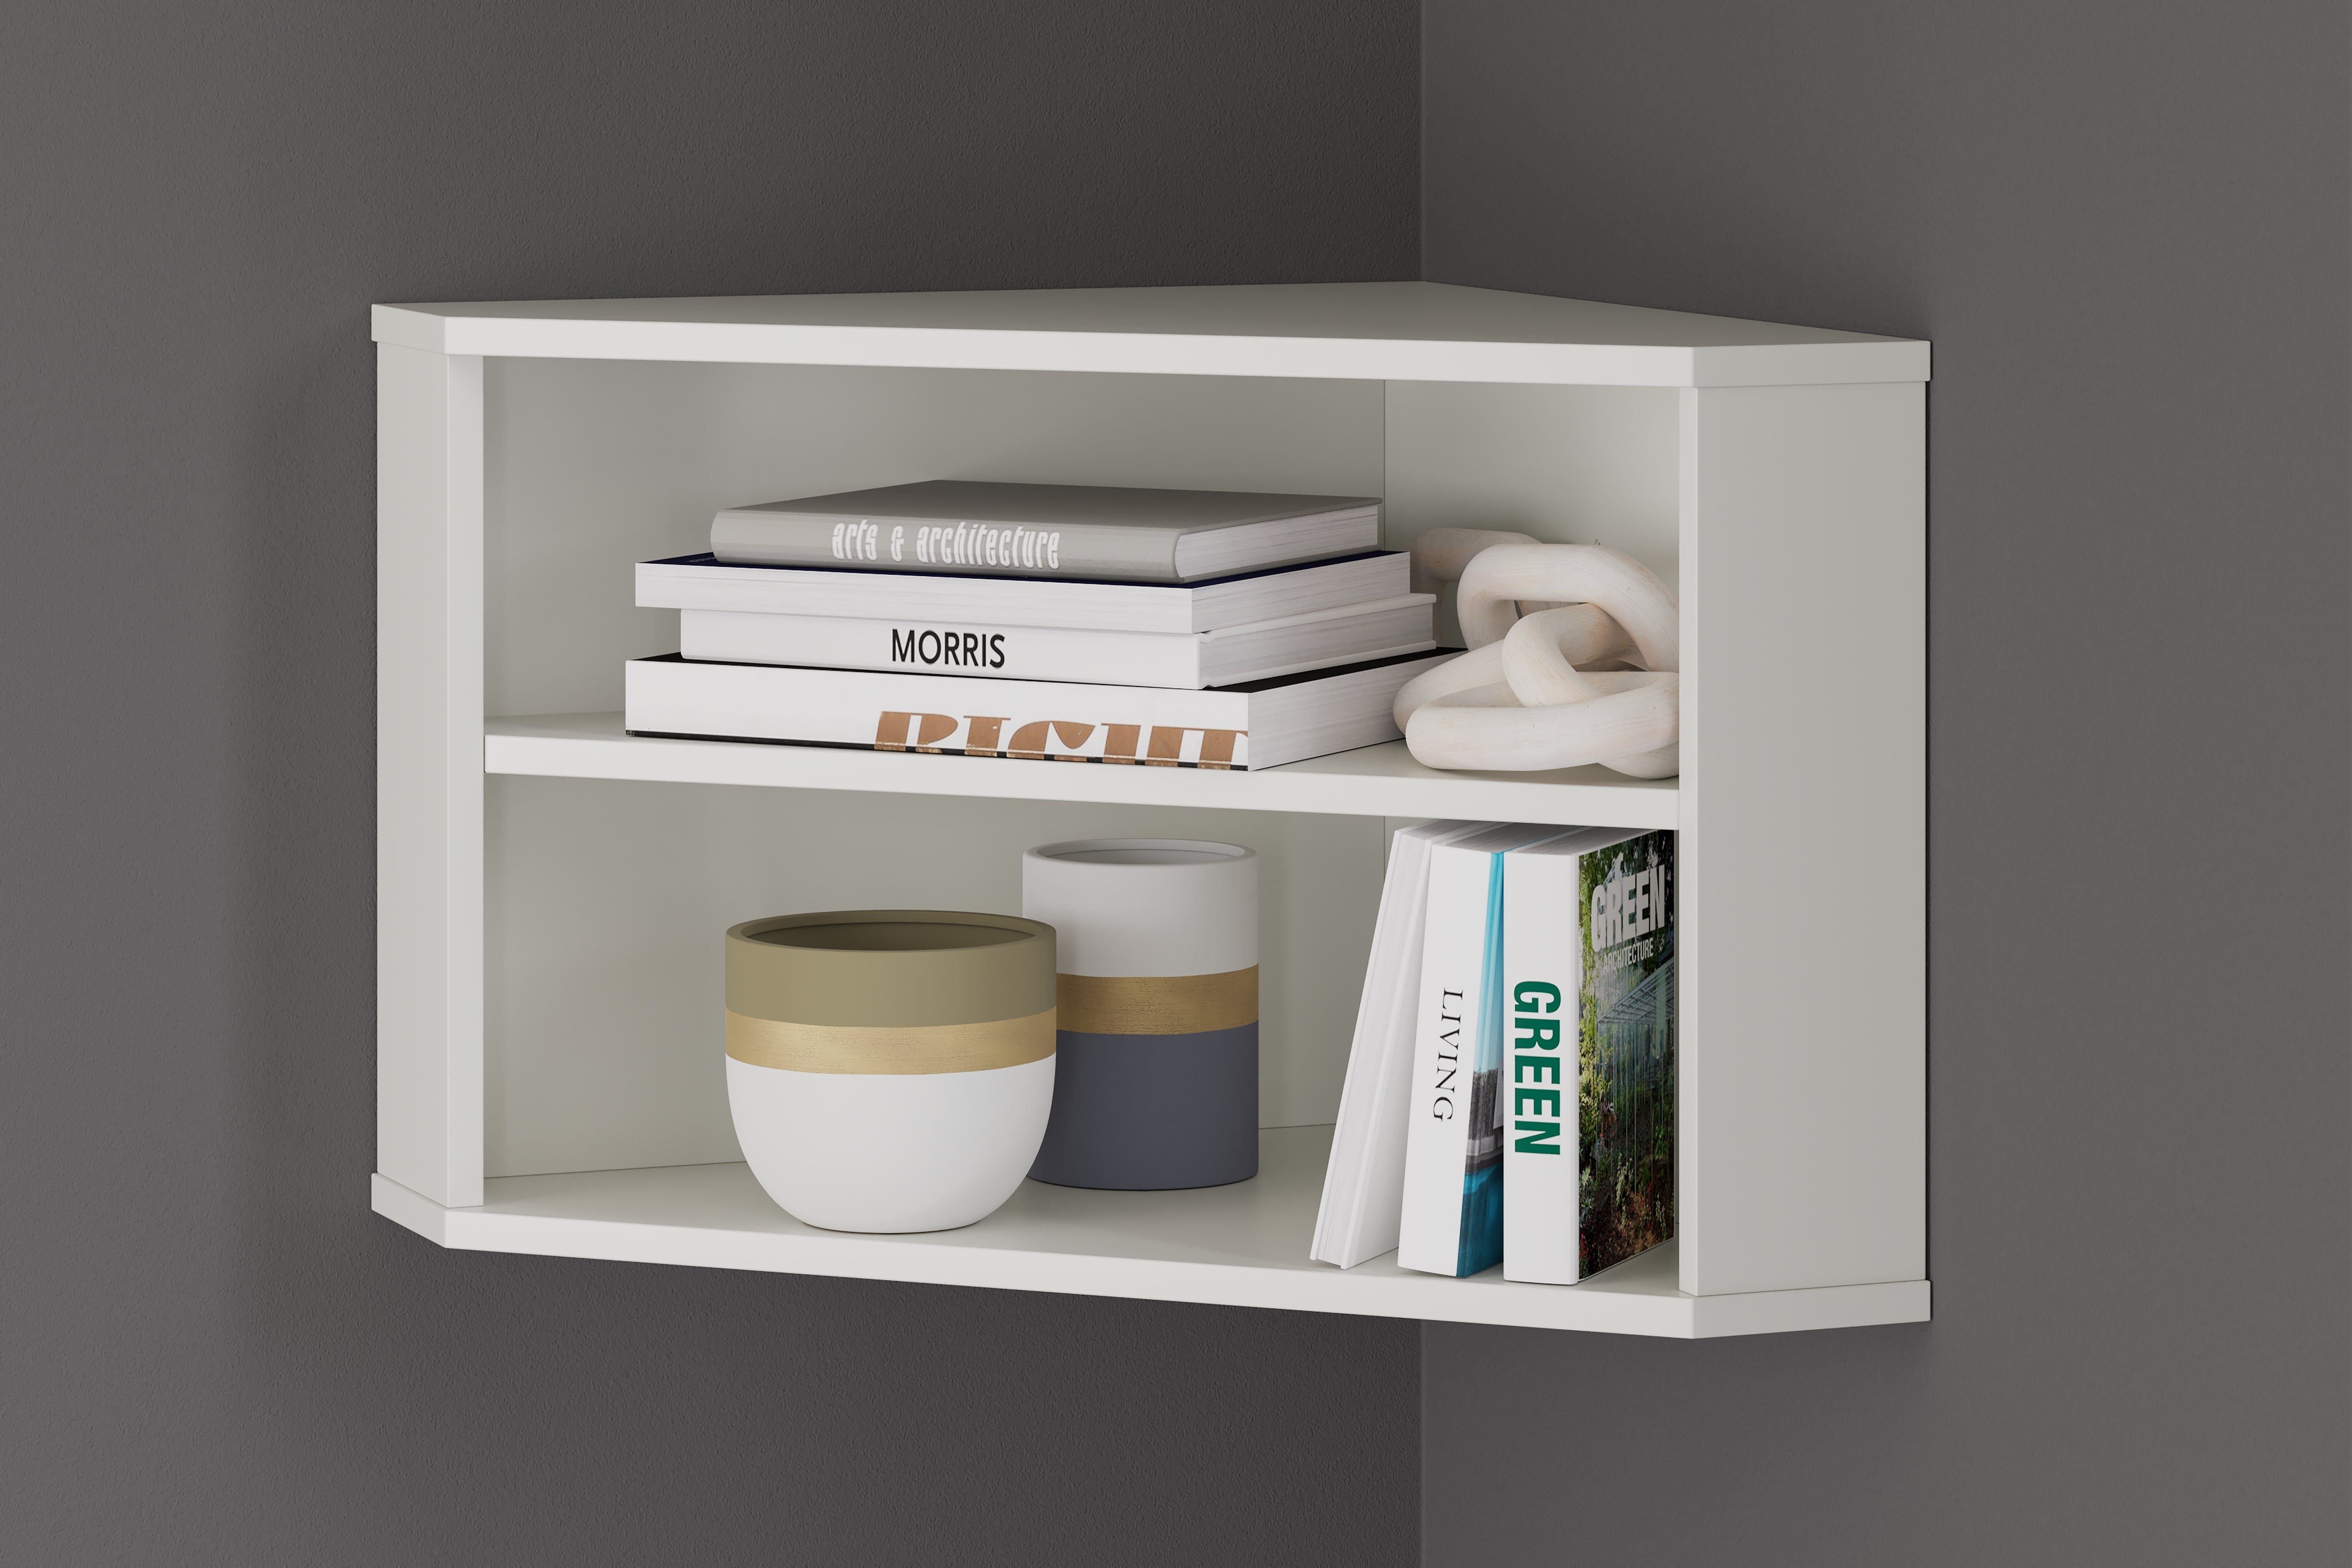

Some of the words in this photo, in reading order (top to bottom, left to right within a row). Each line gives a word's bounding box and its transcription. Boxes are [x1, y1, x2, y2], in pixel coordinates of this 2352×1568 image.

[832, 520, 878, 561] arts
[890, 525, 905, 562] &
[916, 521, 1061, 570] architecture
[891, 628, 1005, 669] MORRIS
[1590, 864, 1665, 953] GREEN
[1602, 937, 1653, 974] ARCHITECTURE
[1433, 988, 1464, 1122] LIVING
[1513, 981, 1561, 1155] GREEN
